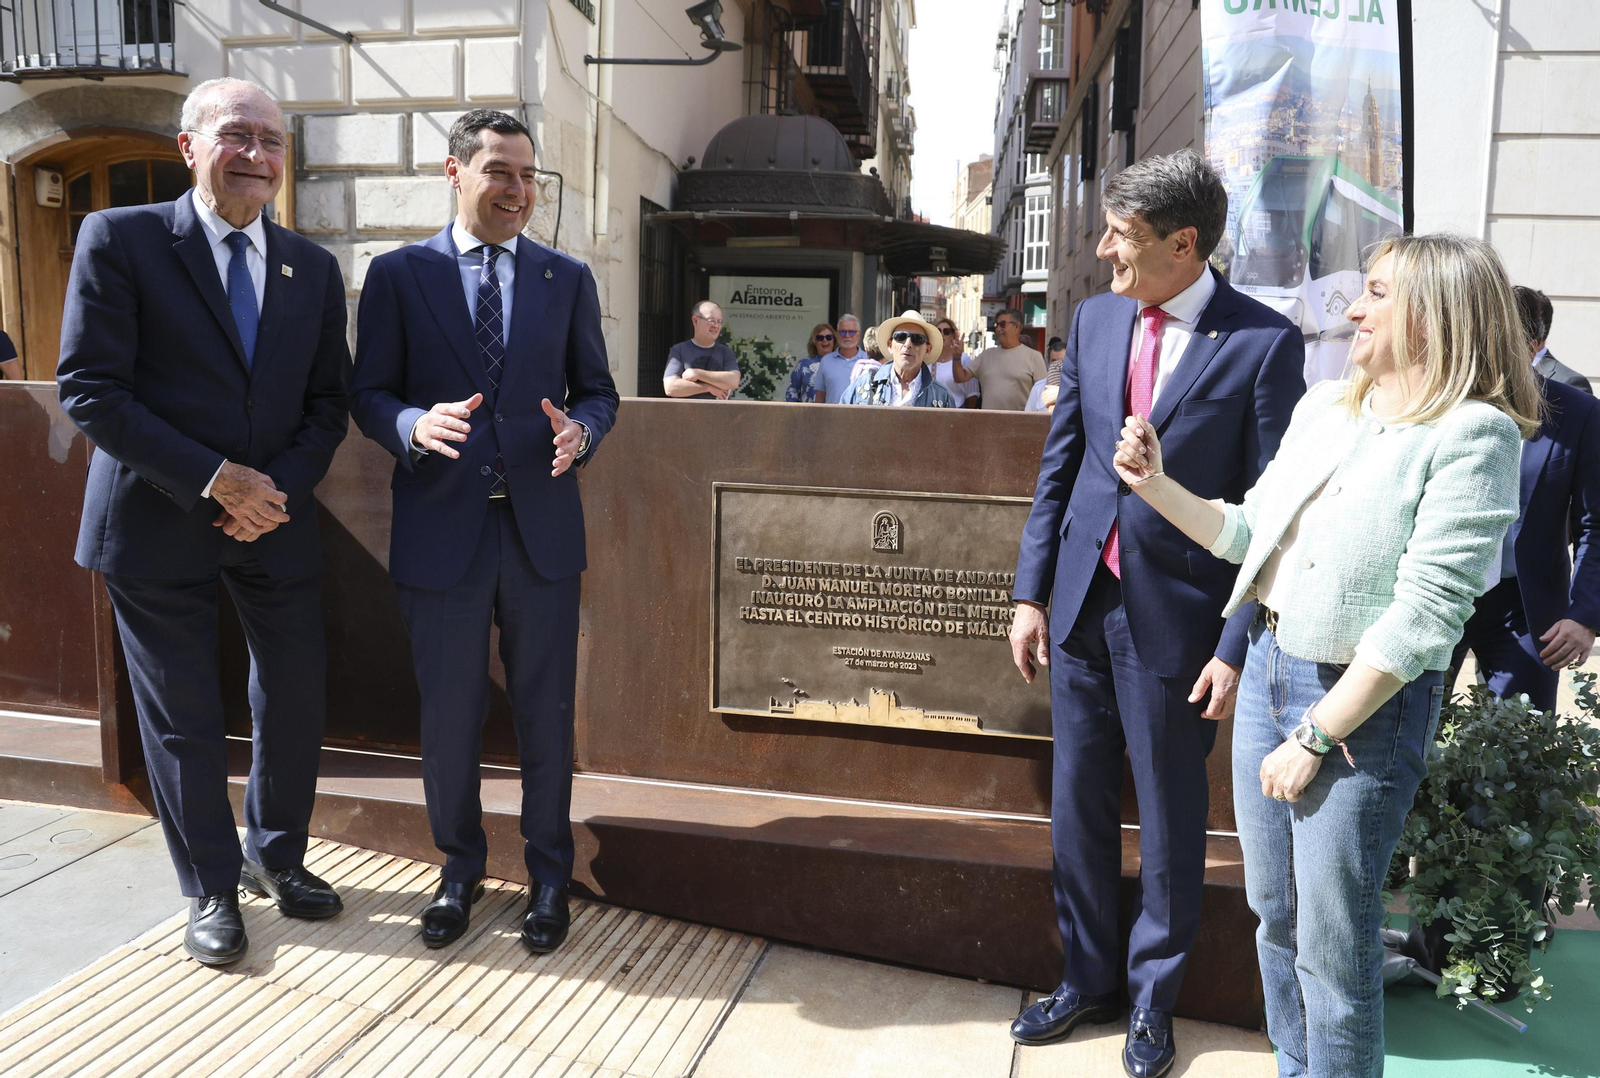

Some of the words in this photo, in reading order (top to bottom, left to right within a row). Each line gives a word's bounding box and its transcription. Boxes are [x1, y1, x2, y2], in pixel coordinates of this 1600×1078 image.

[730, 290, 803, 307] Alameda
[747, 284, 787, 295] Entorno
[735, 556, 751, 570] EL
[754, 558, 840, 575] PRESIDENTE
[843, 563, 862, 576] DE
[865, 565, 882, 578] LA
[885, 566, 931, 581] JUNTA
[935, 569, 954, 582] DE
[956, 570, 1015, 586] ANDALU
[762, 575, 775, 588] D.
[779, 576, 816, 590] JUAN
[820, 578, 877, 594] MANUEL
[880, 582, 943, 598] MORENO
[947, 587, 1008, 602] BONILLA
[751, 590, 824, 608] INAUGURÓ
[827, 595, 844, 609] LA
[847, 597, 934, 615] AMPLIACIÓN
[938, 603, 965, 617] DEL
[740, 606, 784, 621] HASTA
[787, 609, 802, 623] EL
[806, 611, 862, 627] CENTRO
[866, 614, 941, 633] HISTÓRICO
[946, 620, 964, 634] DE
[832, 646, 869, 656] ESTACIÓN
[882, 650, 931, 661] ATARAZANAS
